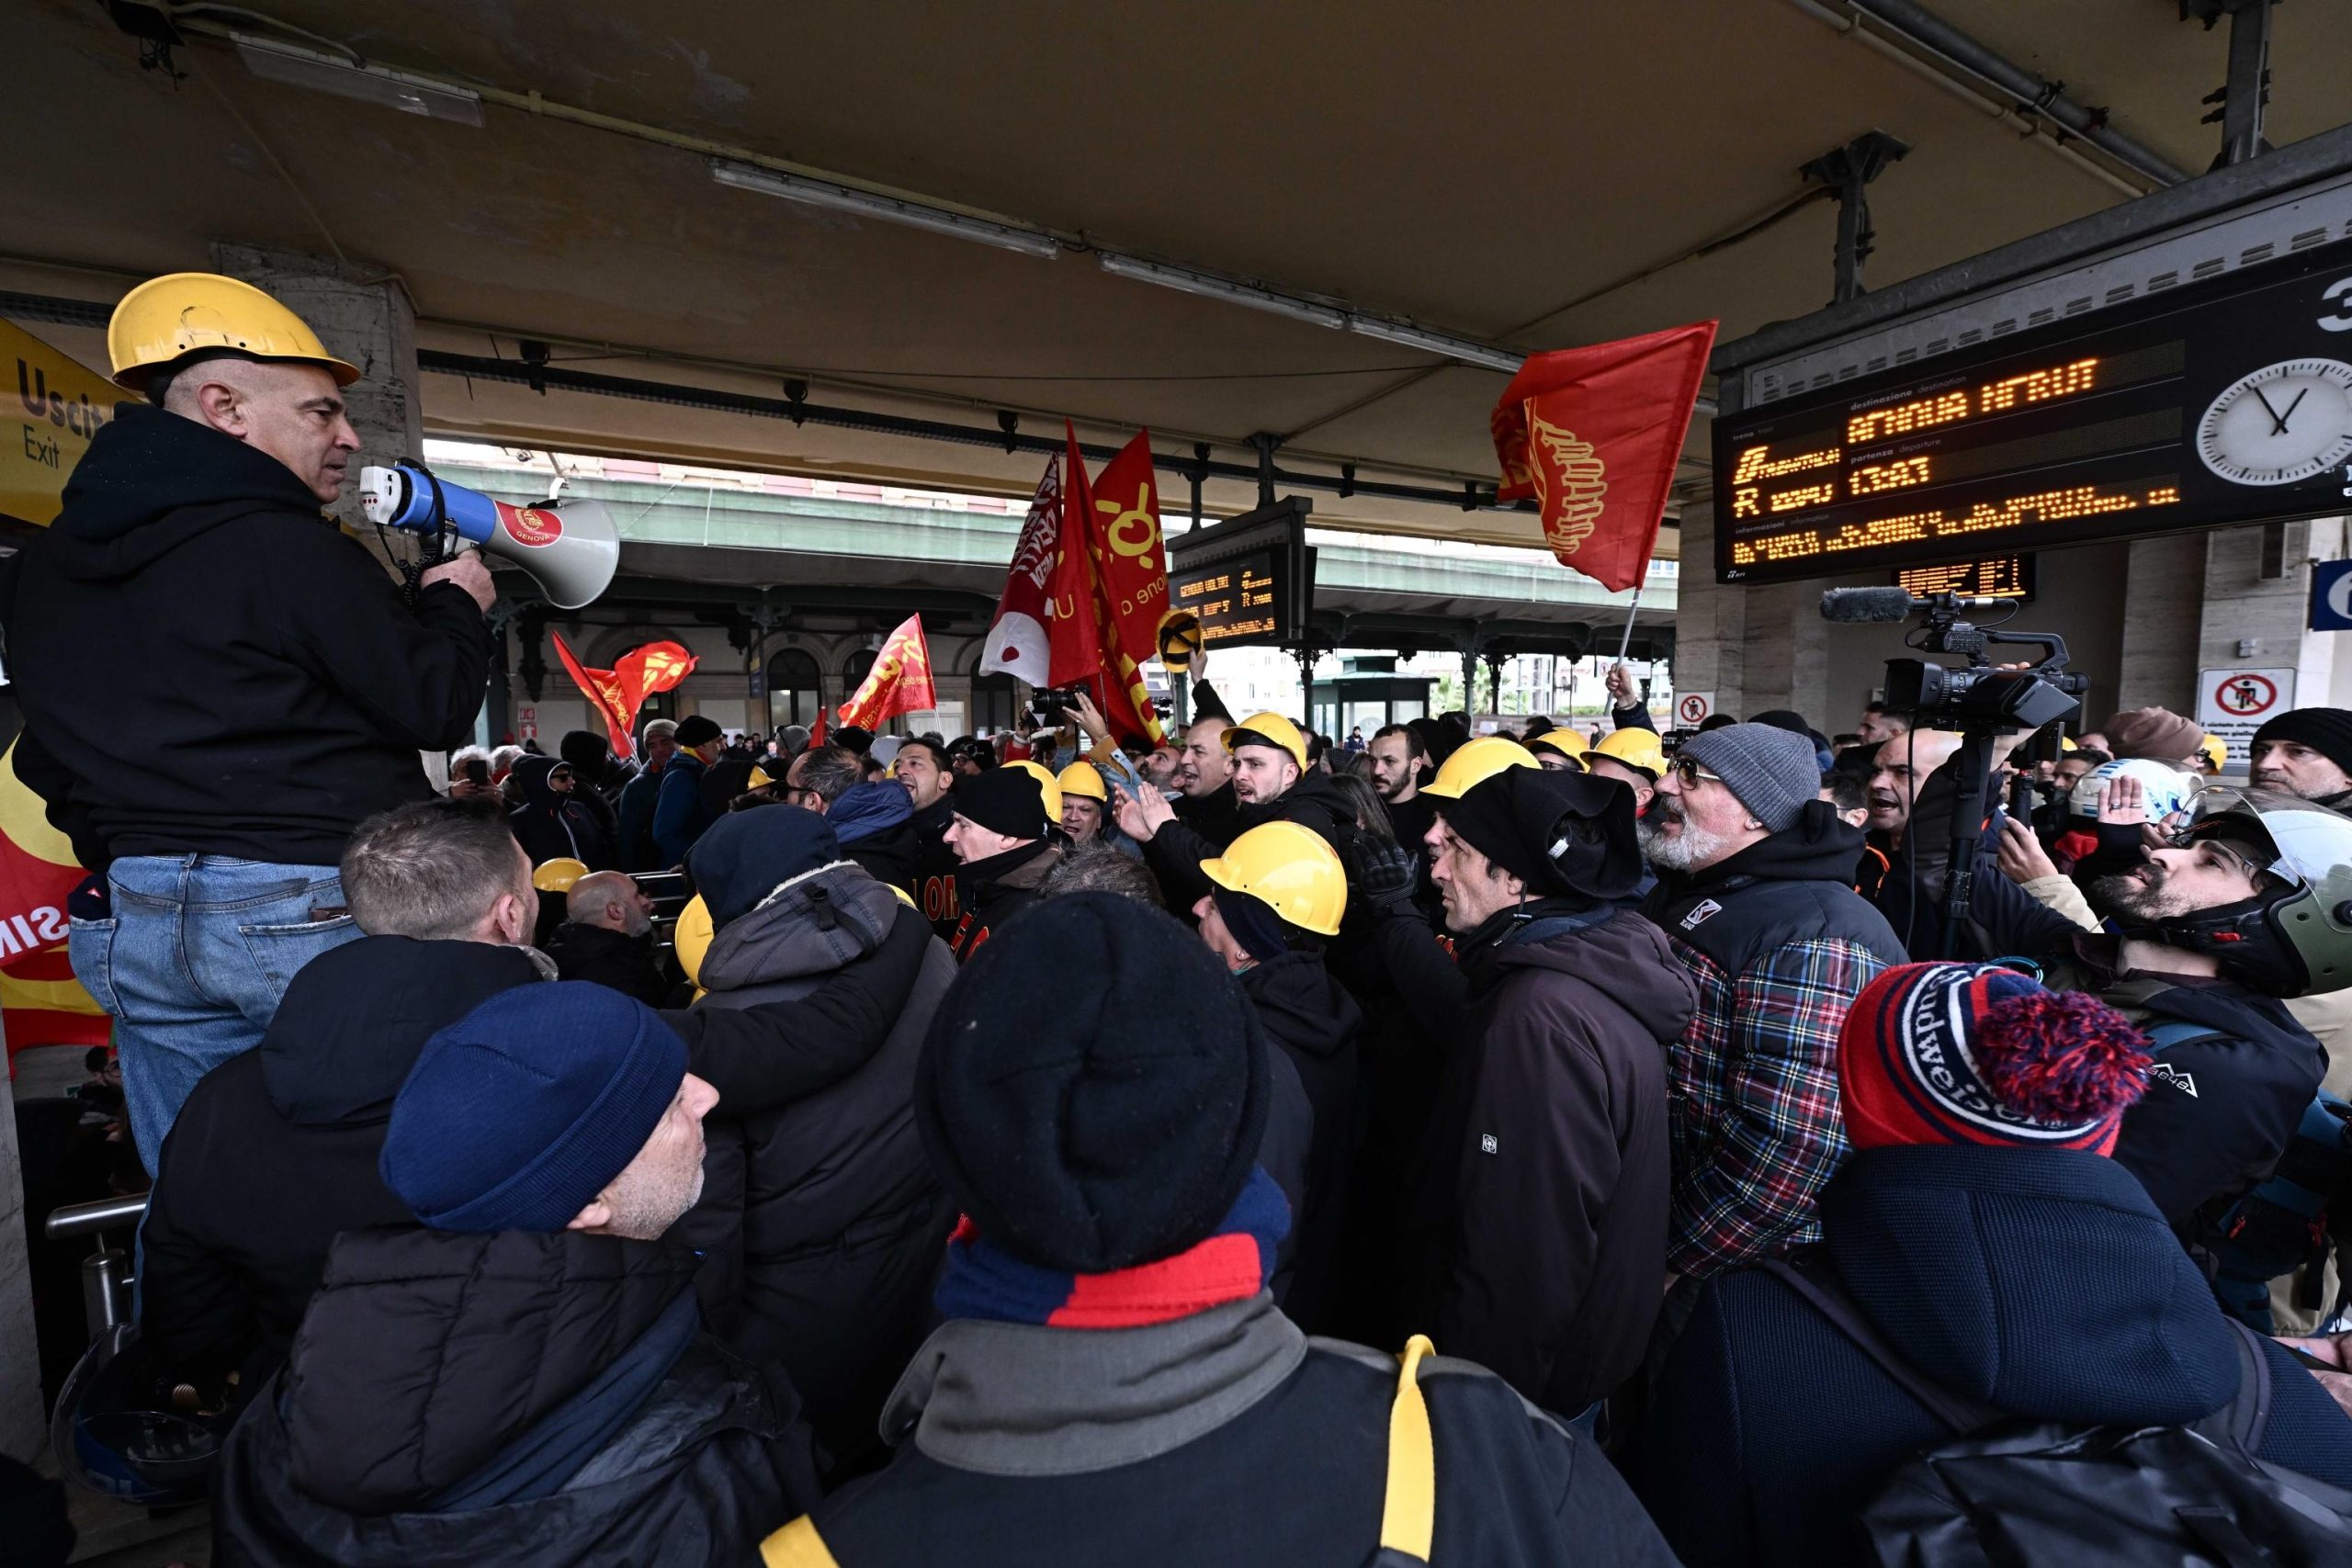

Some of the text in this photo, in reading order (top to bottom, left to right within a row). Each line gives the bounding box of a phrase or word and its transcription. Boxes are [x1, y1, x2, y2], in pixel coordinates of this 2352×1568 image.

[1850, 375, 1967, 412] destinazione destination
[23, 423, 61, 470] Exit
[1733, 431, 1755, 442] treno
[1850, 438, 1942, 465] partenza departure
[1733, 488, 1760, 518] R
[516, 530, 551, 542] GENOVA
[1735, 521, 1785, 536] informazioni
